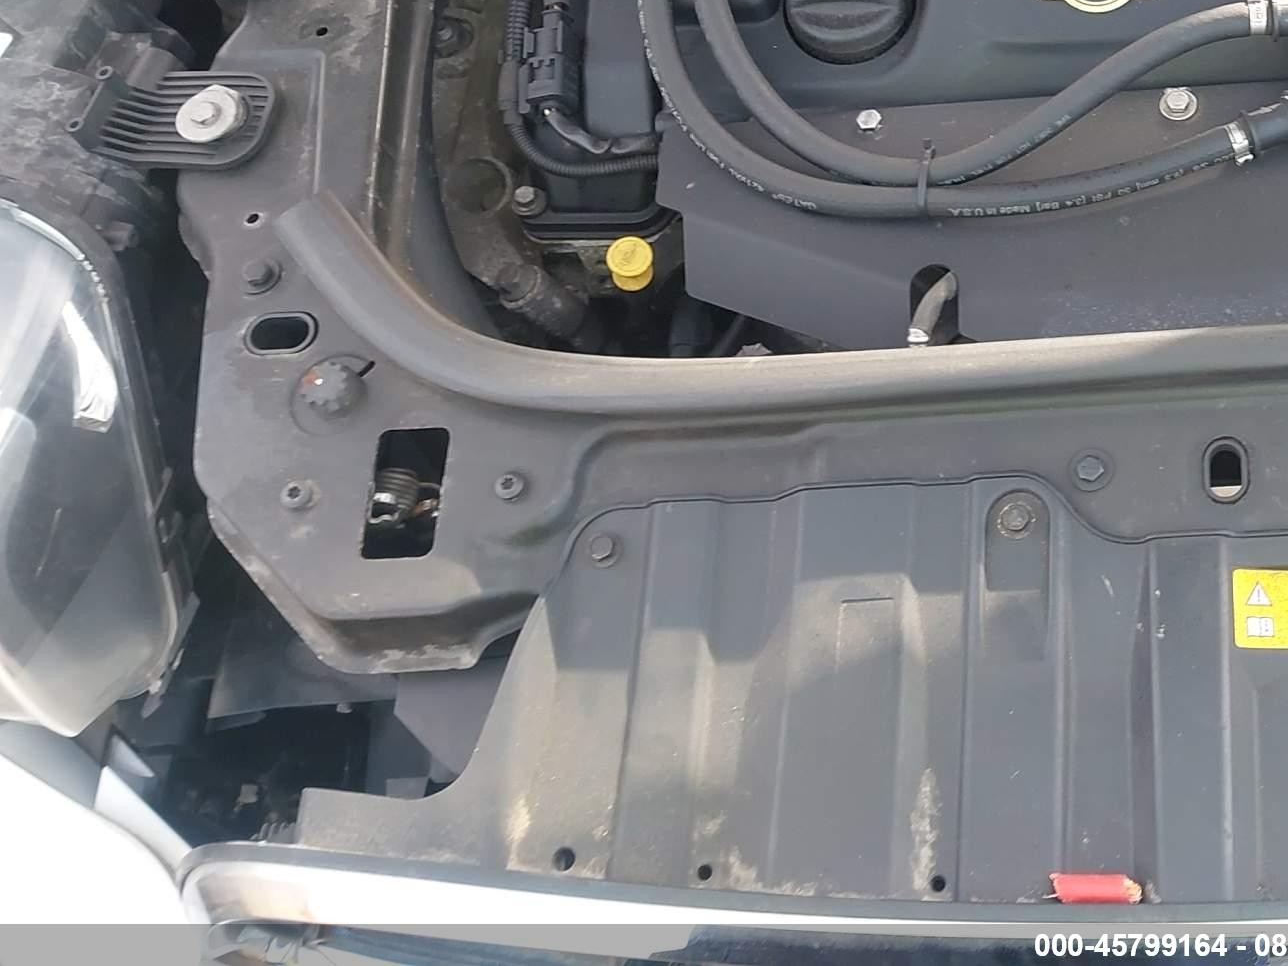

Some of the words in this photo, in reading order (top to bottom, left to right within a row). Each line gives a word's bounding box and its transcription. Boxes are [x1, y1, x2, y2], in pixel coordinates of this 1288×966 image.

[946, 207, 984, 216] U.S.A.
[987, 207, 997, 216] in
[1000, 205, 1030, 215] Made
